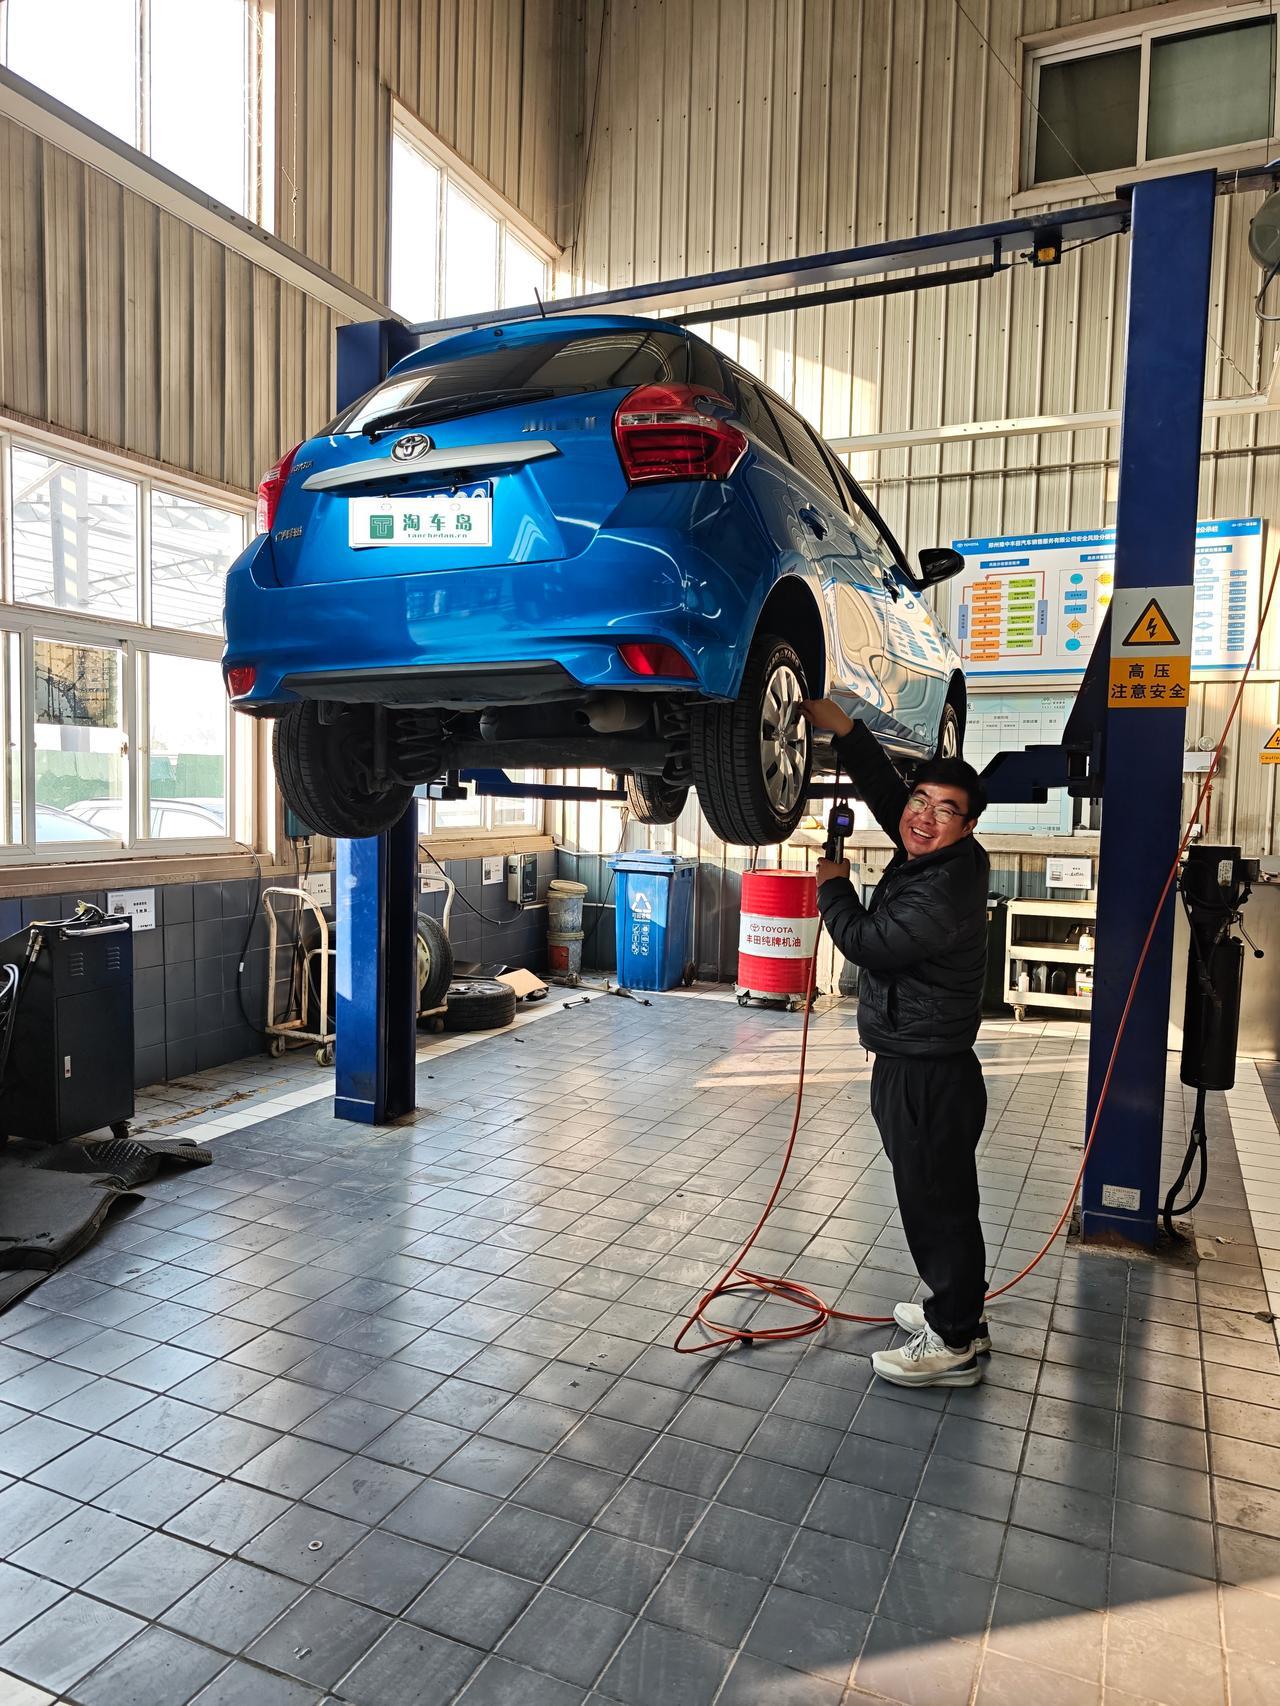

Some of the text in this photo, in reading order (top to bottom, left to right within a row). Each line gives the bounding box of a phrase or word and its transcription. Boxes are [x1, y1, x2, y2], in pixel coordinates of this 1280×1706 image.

[1128, 663, 1171, 679] 高压
[1111, 683, 1186, 699] 注意安全
[761, 925, 794, 934] TOYOTA
[746, 934, 802, 947] 丰田纯牌机油
